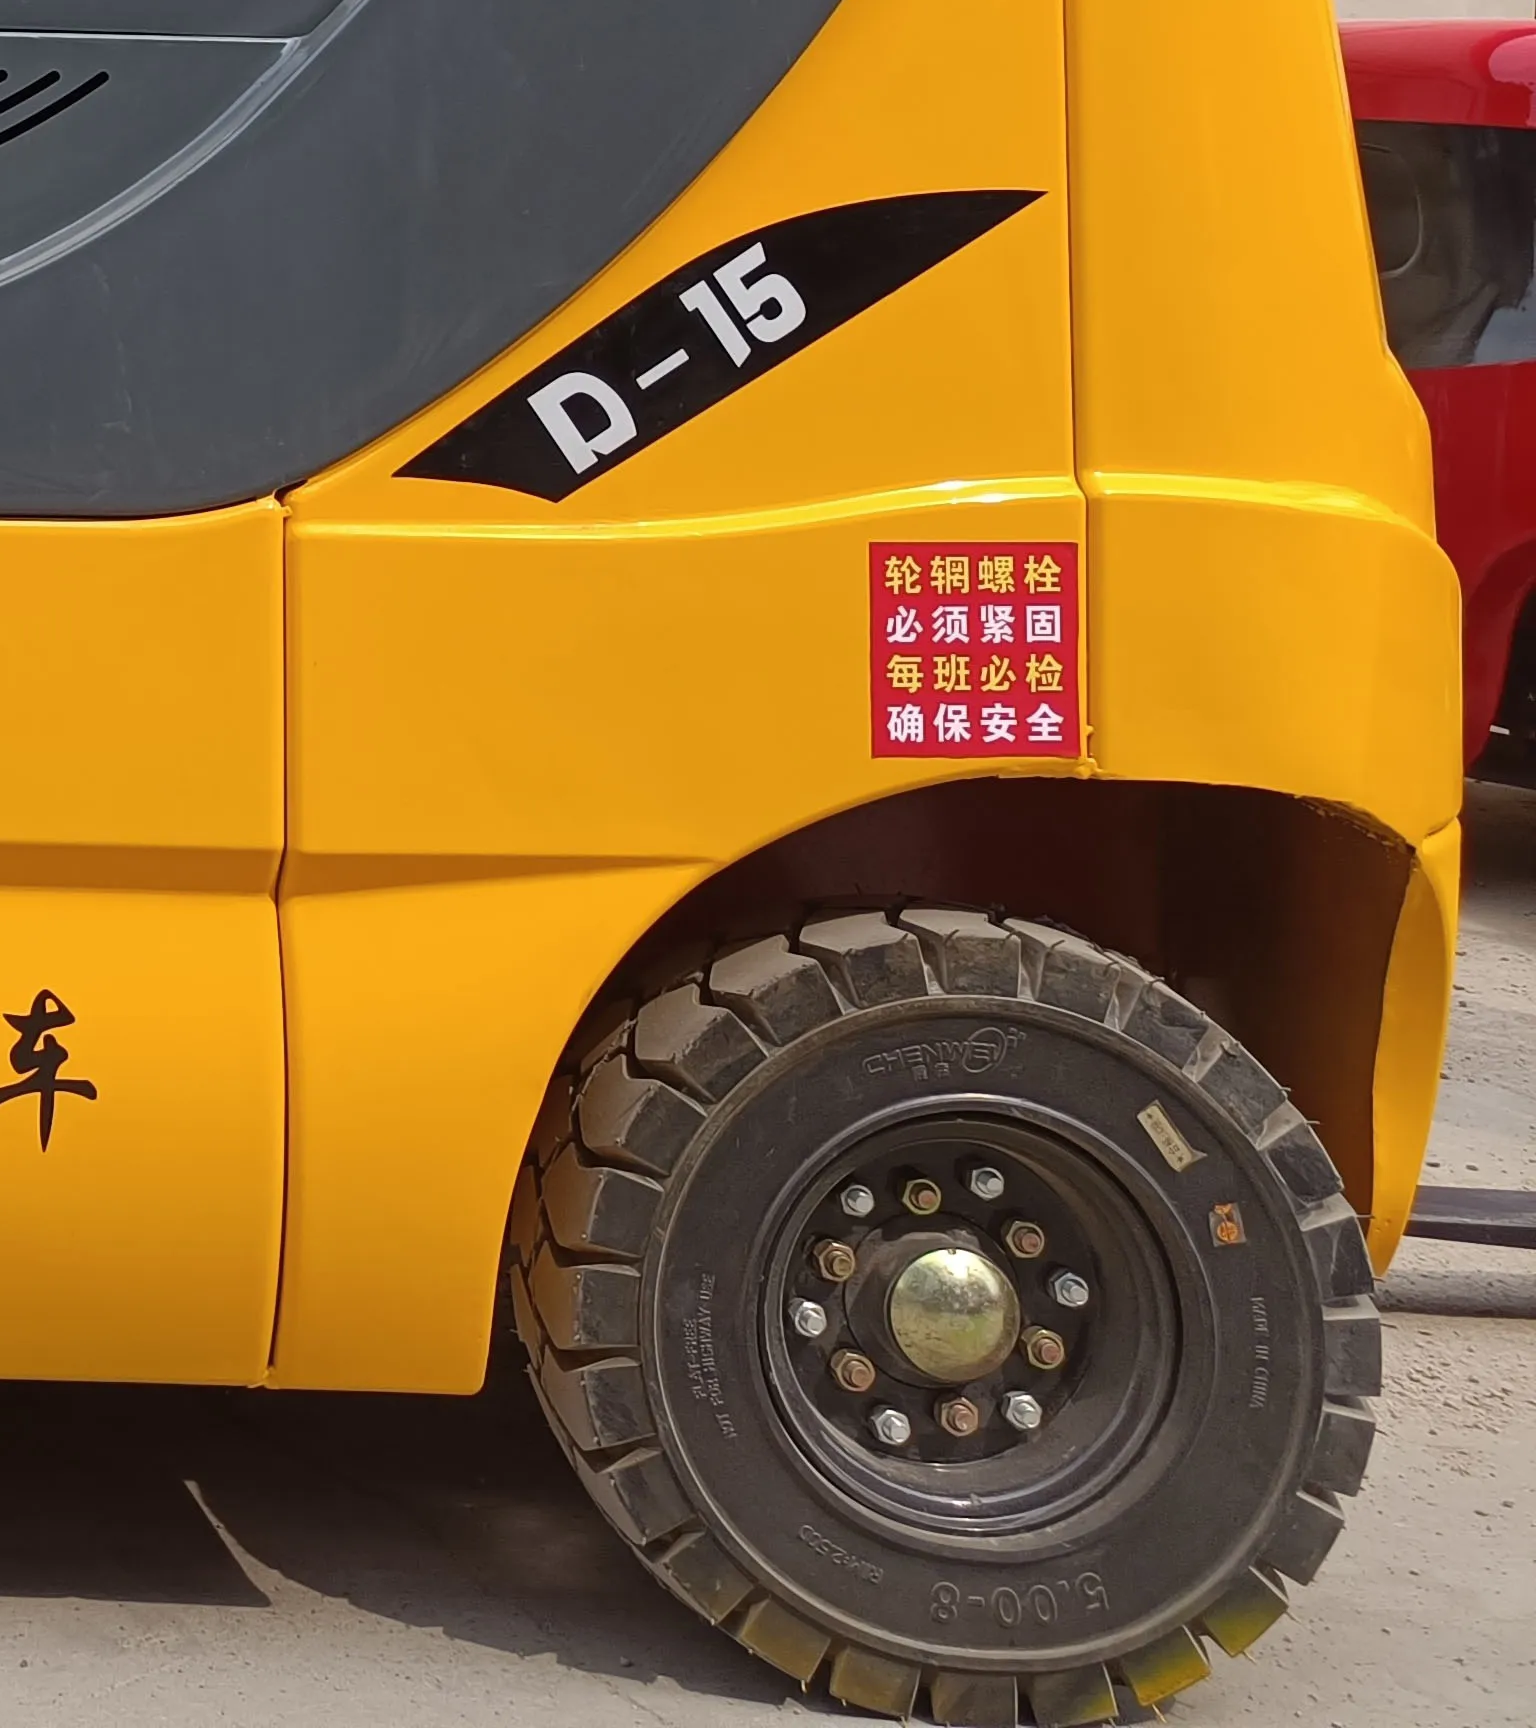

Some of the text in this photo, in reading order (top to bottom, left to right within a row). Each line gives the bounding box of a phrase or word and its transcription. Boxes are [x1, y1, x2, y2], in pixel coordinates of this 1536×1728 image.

[526, 241, 807, 475] D-15
[884, 554, 1063, 595] 轮辋螺栓
[886, 604, 1063, 644] 必须紧固
[886, 653, 1064, 694] 每班必检
[886, 702, 1065, 744] 确保安全
[929, 1571, 1111, 1627] 5.00-8
